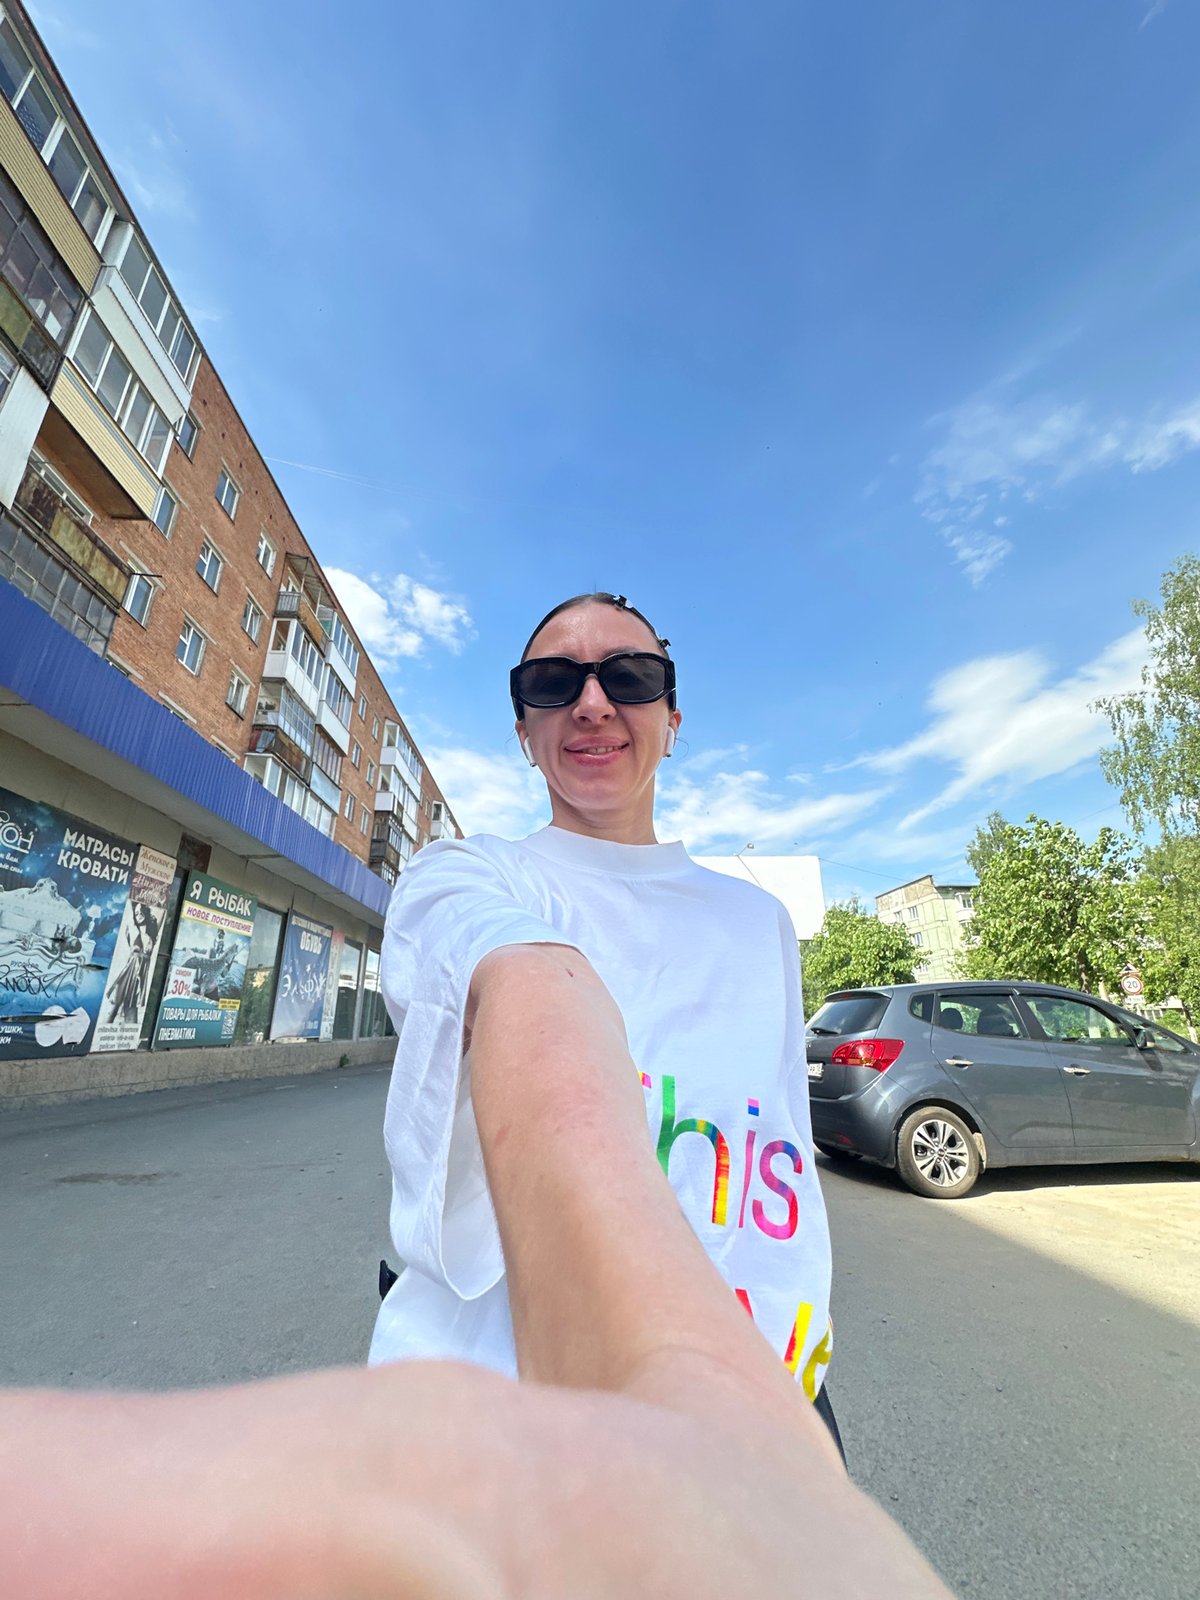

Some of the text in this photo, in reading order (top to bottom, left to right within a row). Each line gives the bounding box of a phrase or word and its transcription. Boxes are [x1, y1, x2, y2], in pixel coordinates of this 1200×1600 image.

[63, 827, 135, 867] МАТРАСЫ
[57, 849, 130, 885] КРОВАТИ
[190, 880, 252, 917] Я РЫБАК
[187, 906, 253, 933] НОВОЕ ПОСТУПЛЕНИЕ
[300, 930, 323, 955] ОБУВЬ
[171, 979, 192, 996] 30%
[1126, 981, 1138, 989] 20
[163, 1008, 222, 1021] ТОВАРЫ ДЛЯ РЫБАЛКИ
[158, 1028, 197, 1041] ПНЕВМАТИКА
[637, 1070, 803, 1240] his
